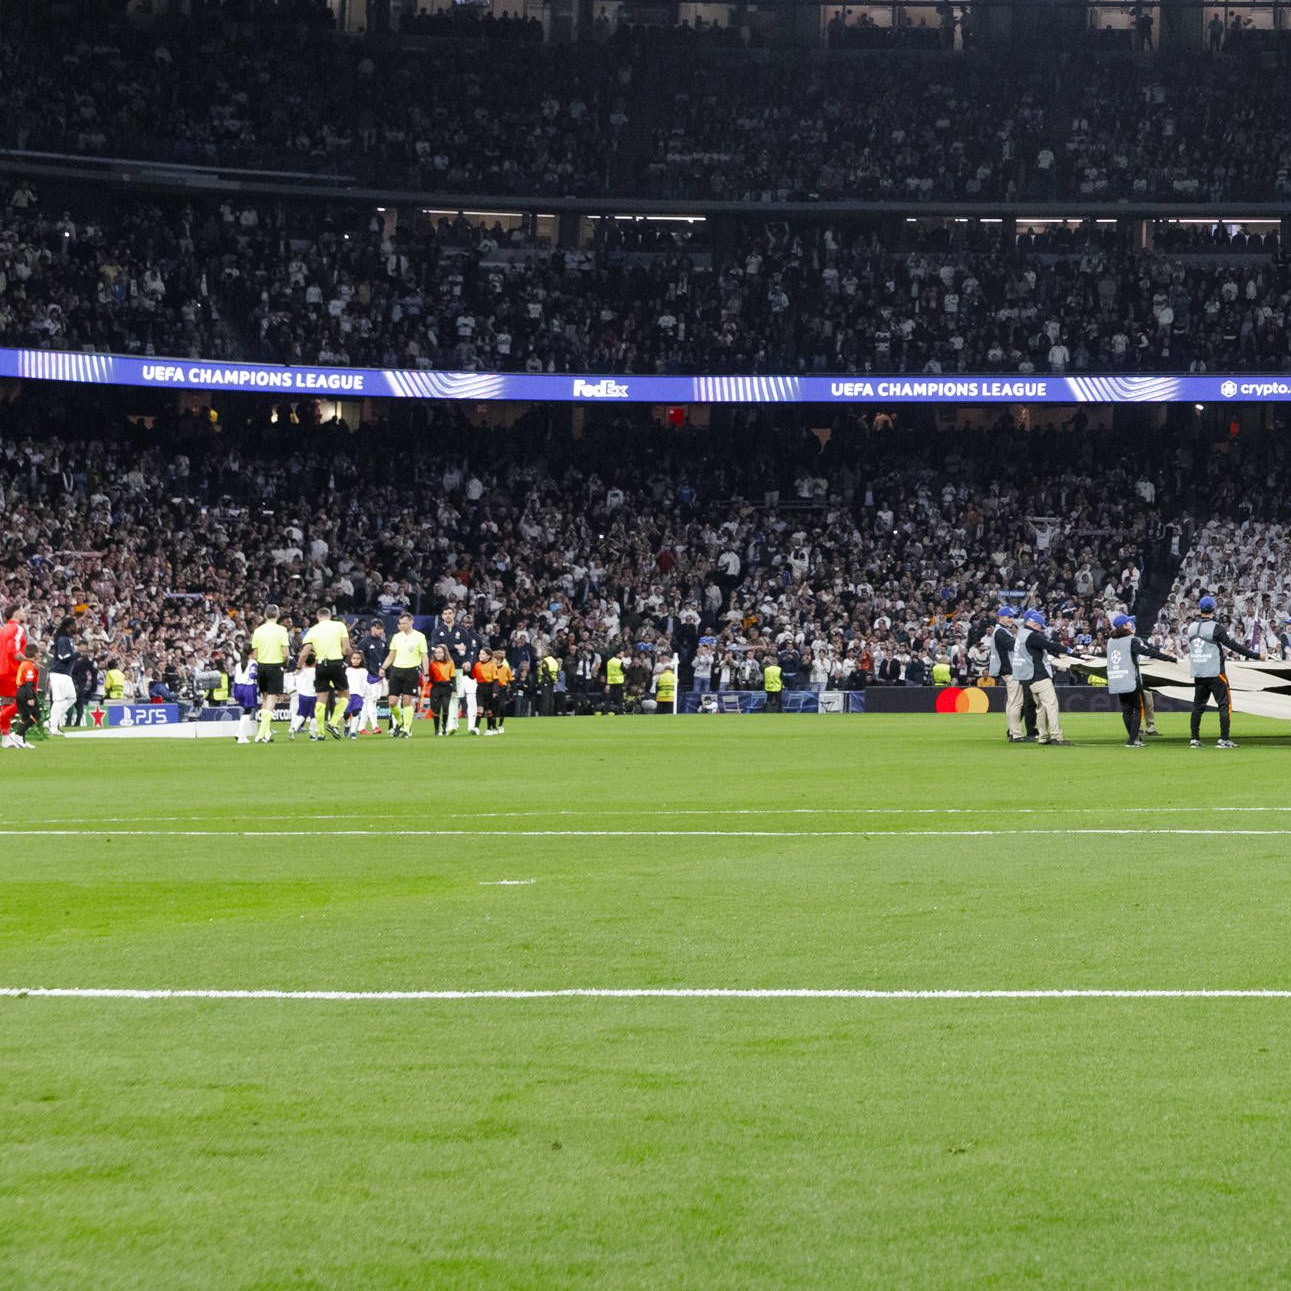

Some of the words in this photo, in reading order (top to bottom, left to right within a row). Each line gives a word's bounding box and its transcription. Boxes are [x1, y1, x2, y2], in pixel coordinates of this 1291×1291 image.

[142, 365, 185, 383] UEFA
[188, 367, 293, 389] CHAMPIONS
[295, 371, 364, 391] LEAGUE
[573, 379, 629, 397] FedEx
[831, 381, 874, 397] UEFA
[877, 382, 979, 397] CHAMPIONS
[981, 382, 1047, 398] LEAGUE
[135, 708, 168, 724] PS5
